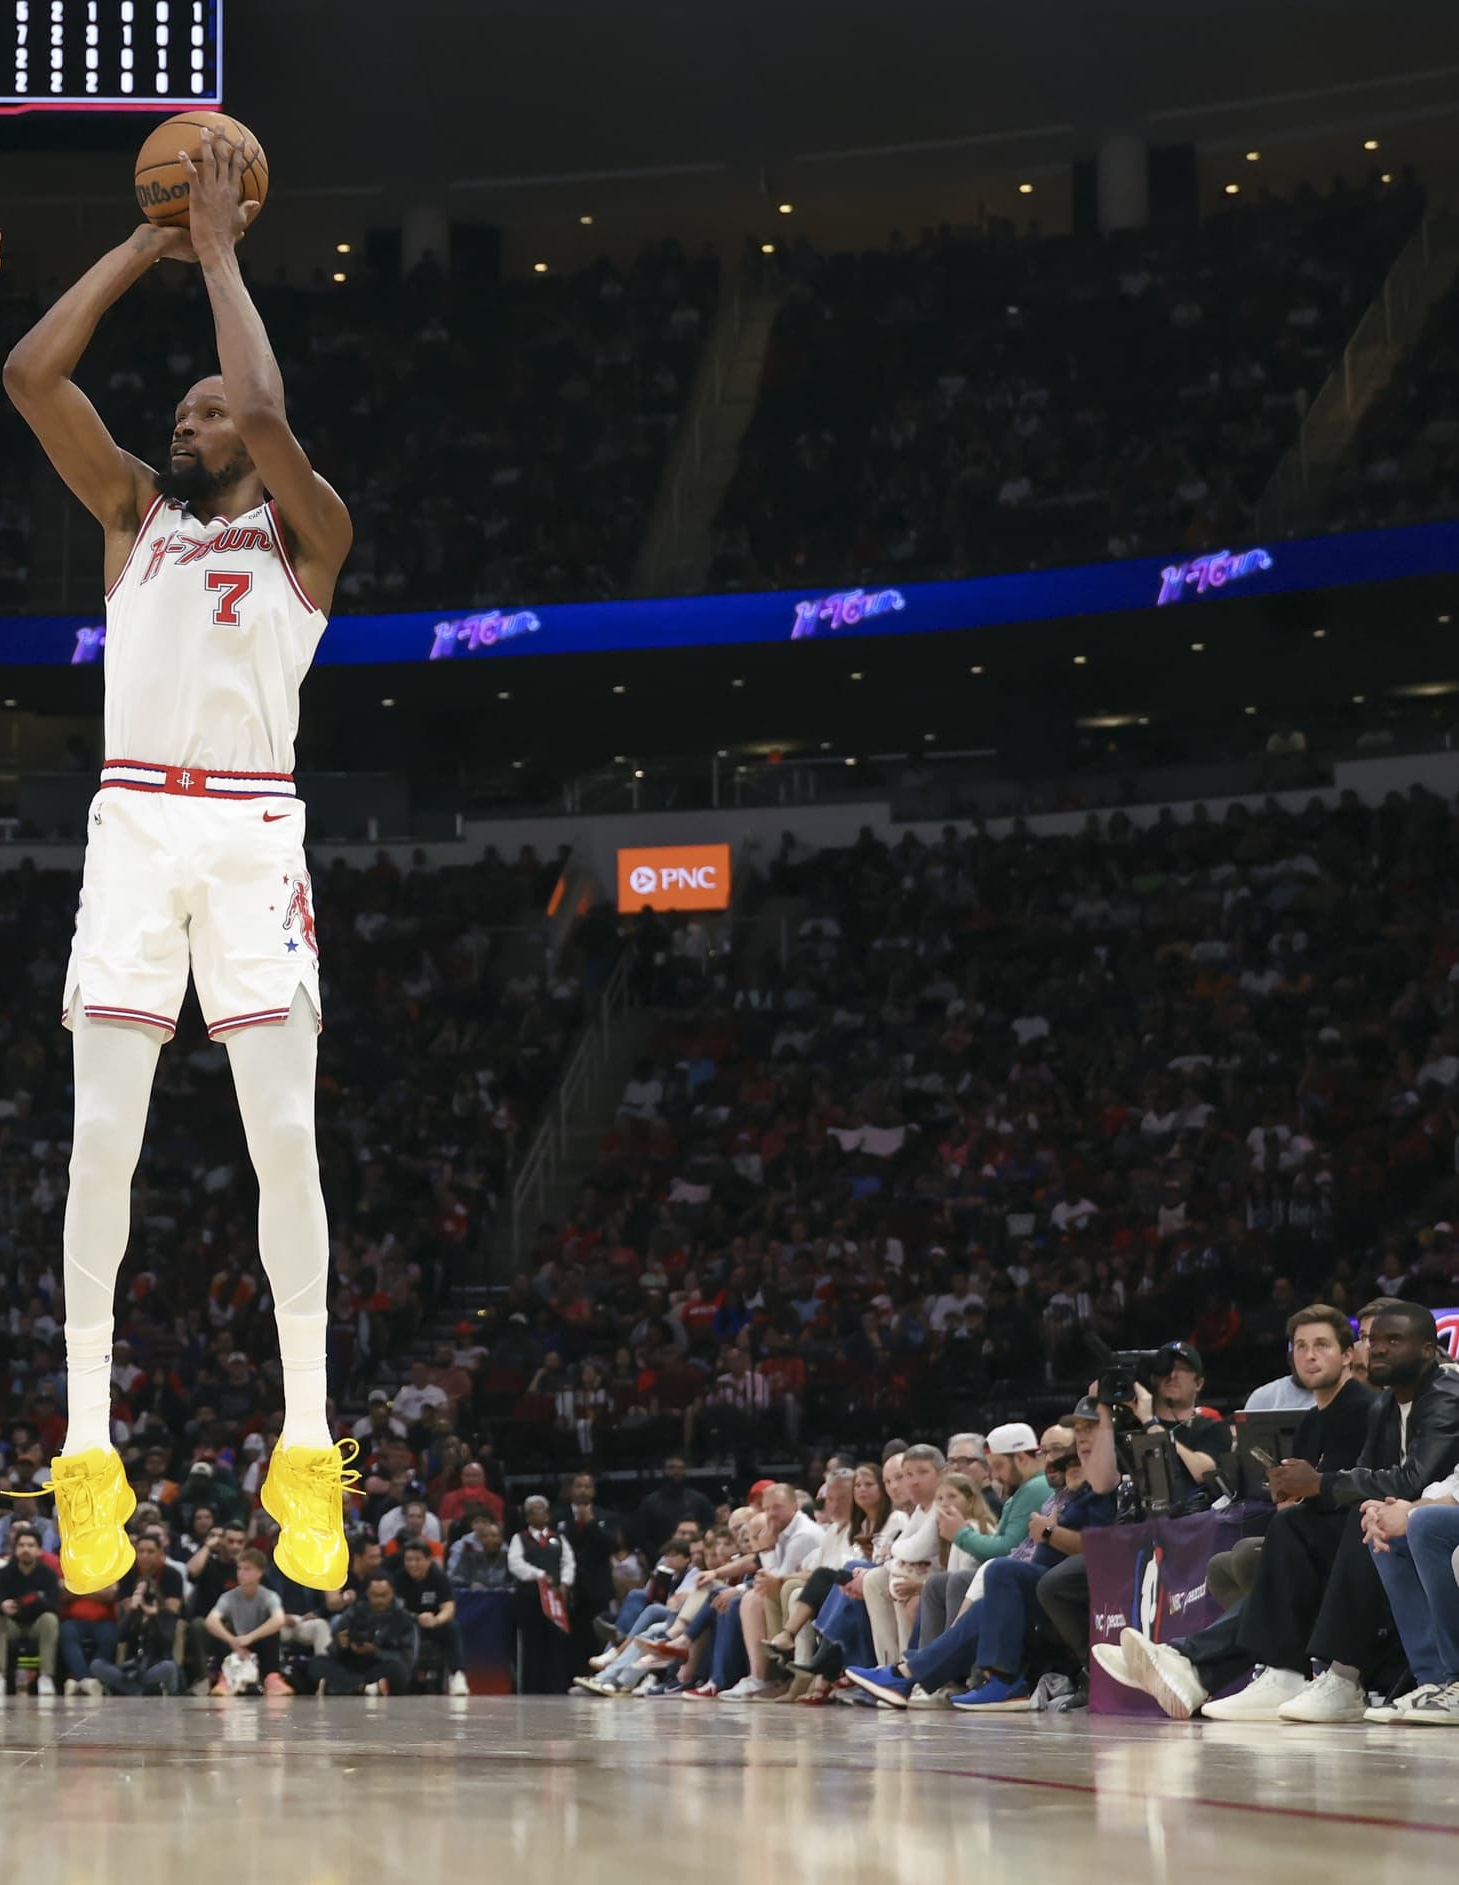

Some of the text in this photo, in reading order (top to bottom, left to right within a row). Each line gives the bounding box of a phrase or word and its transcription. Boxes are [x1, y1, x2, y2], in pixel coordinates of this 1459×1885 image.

[51, 1, 63, 22] 2
[88, 1, 97, 22] 1
[193, 1, 202, 22] 1
[16, 25, 28, 45] 7
[51, 25, 63, 45] 2
[122, 25, 132, 45] 1
[16, 48, 28, 69] 2
[158, 48, 167, 69] 1
[15, 72, 28, 93] 2
[50, 72, 63, 93] 2
[86, 72, 98, 93] 2
[204, 569, 253, 627] 7
[659, 865, 717, 891] PNC
